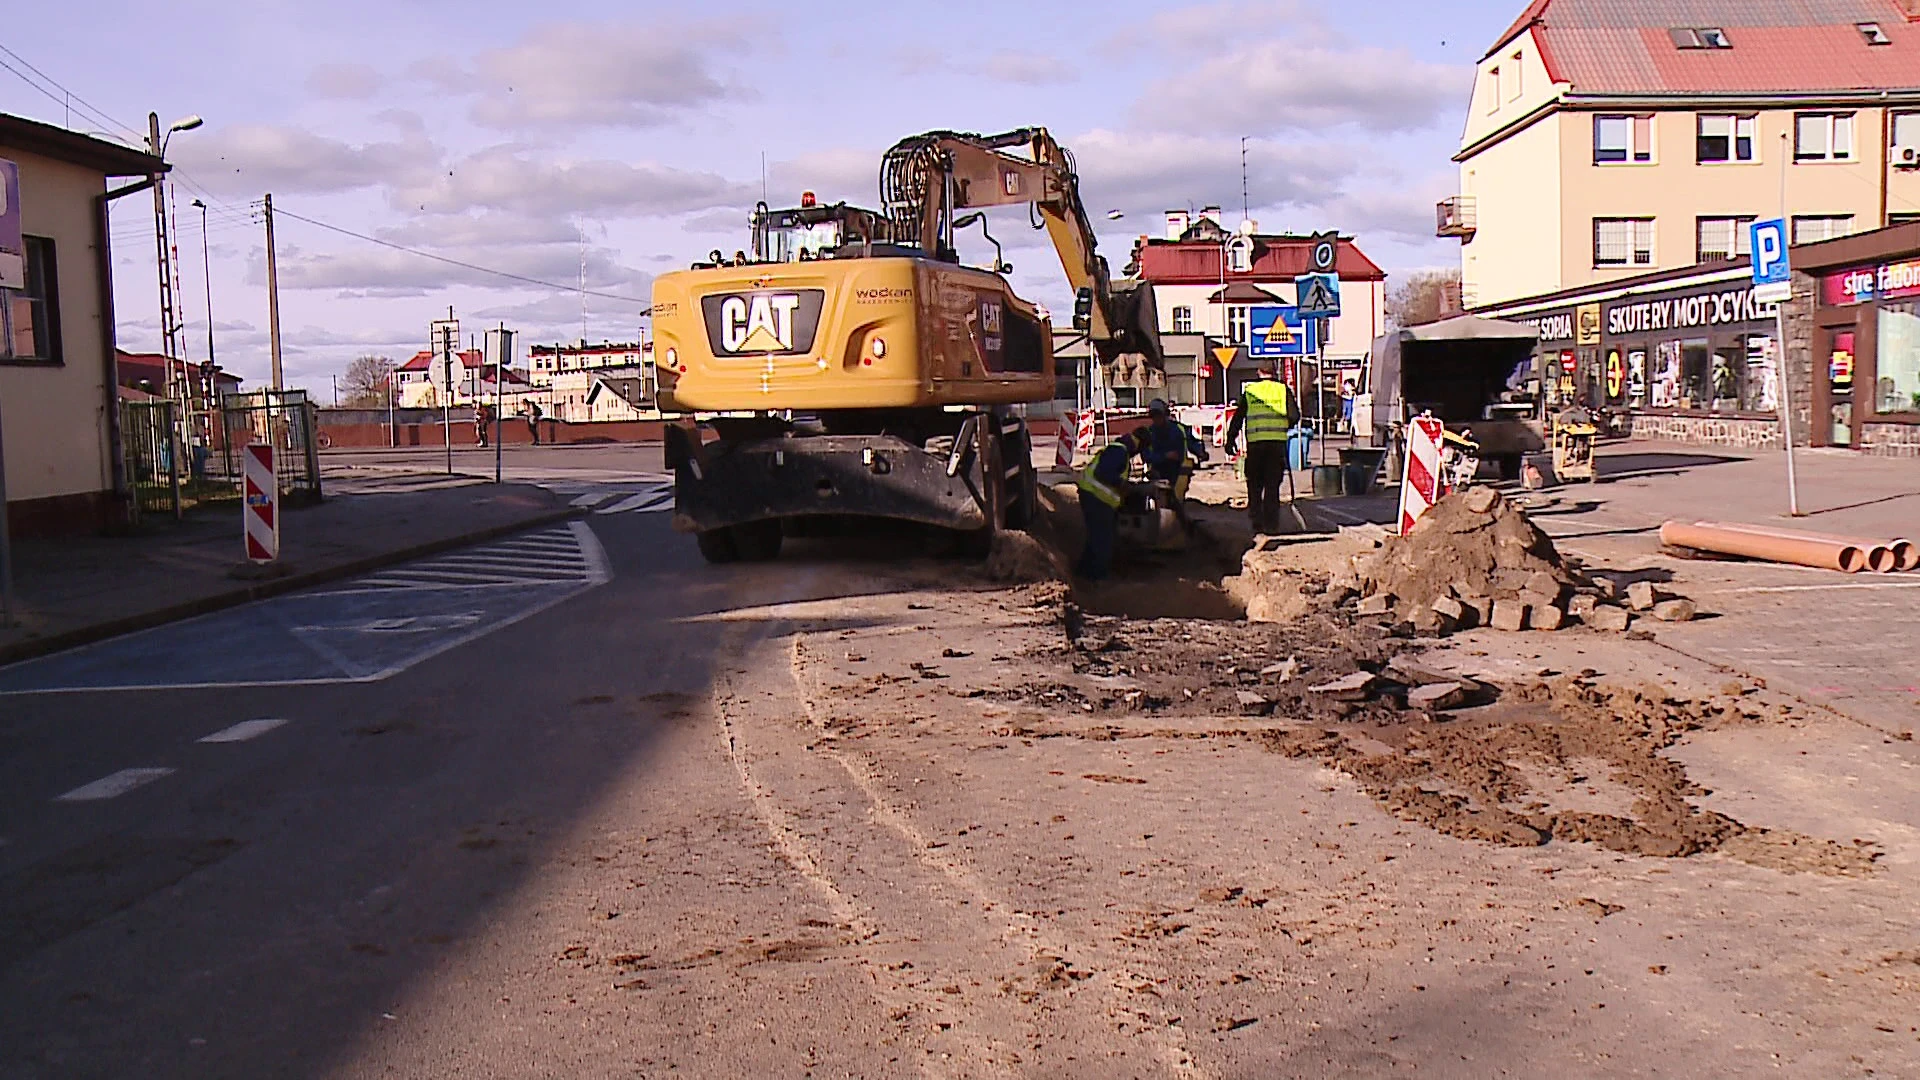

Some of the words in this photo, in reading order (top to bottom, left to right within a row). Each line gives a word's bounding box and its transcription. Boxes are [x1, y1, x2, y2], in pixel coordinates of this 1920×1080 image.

[1756, 225, 1781, 277] P
[721, 294, 800, 352] CAT
[982, 302, 1000, 333] CAT
[1608, 300, 1671, 334] SKUTERY
